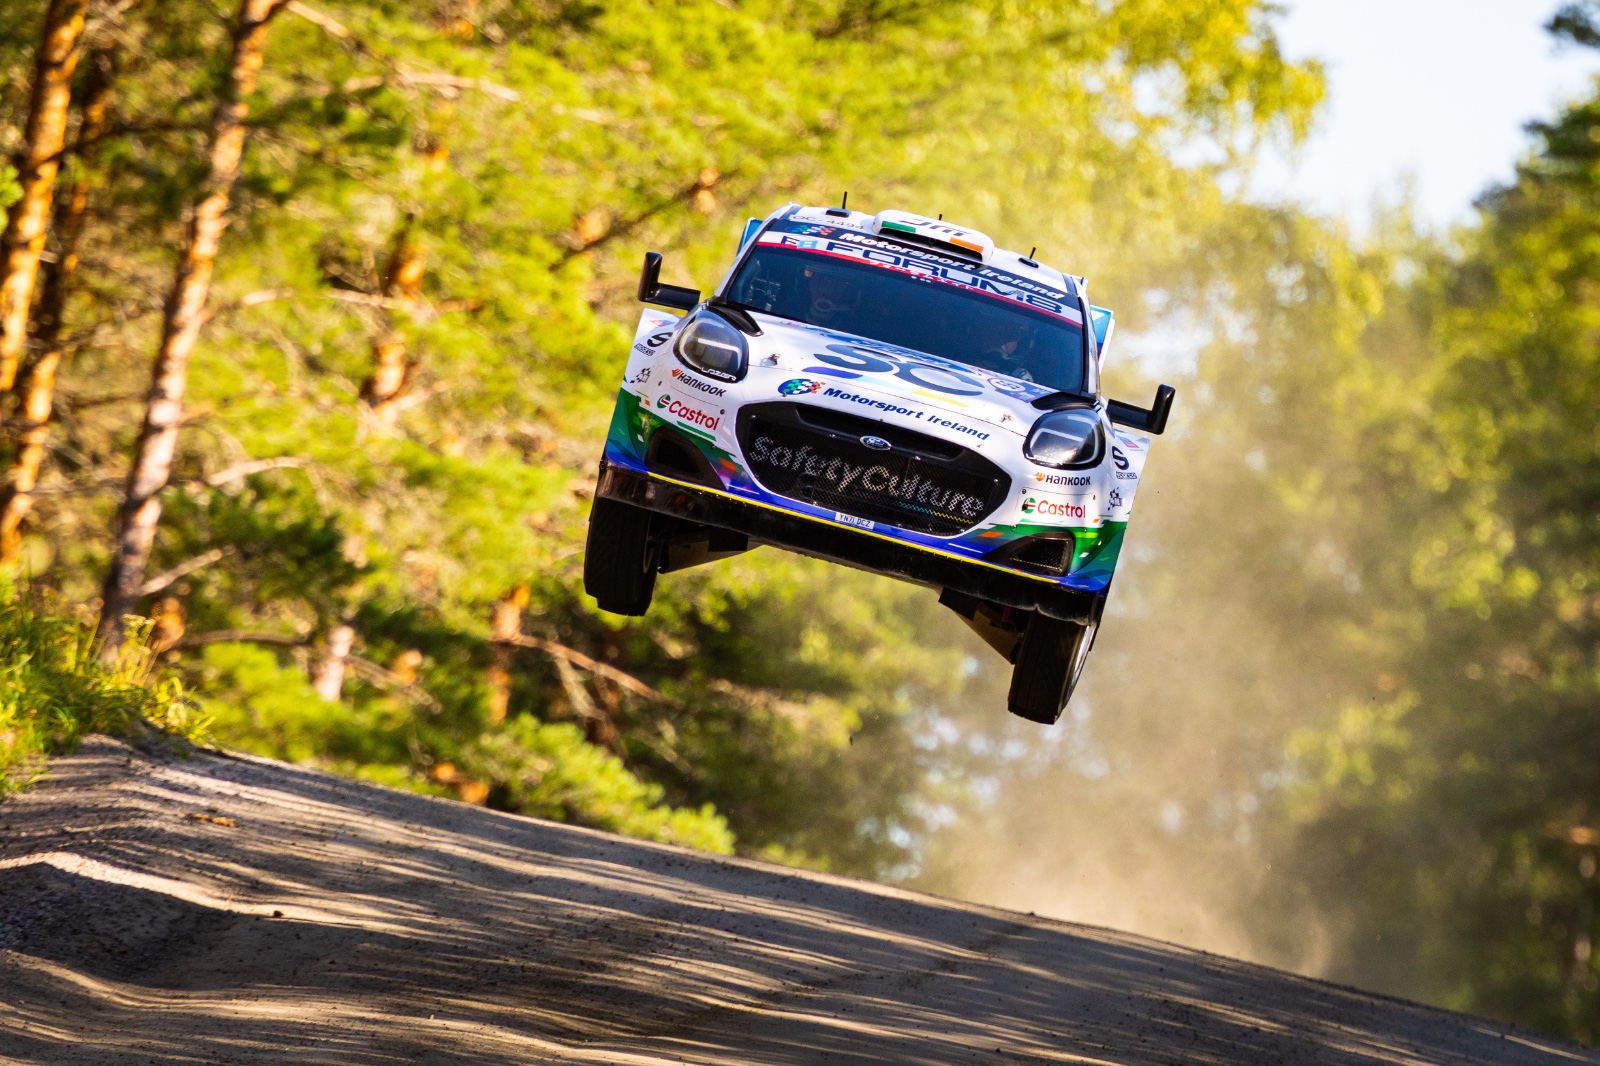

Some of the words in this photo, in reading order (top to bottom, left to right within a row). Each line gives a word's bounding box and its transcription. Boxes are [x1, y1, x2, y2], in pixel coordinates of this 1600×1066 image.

[826, 241, 1063, 314] FORUM8
[838, 232, 976, 271] Motorsport
[979, 267, 1066, 299] Ireland
[668, 400, 720, 431] Castrol
[823, 387, 925, 419] Motorsport
[927, 414, 991, 442] Ireland
[749, 436, 984, 517] SafetyCulture
[1037, 499, 1086, 519] Castrol
